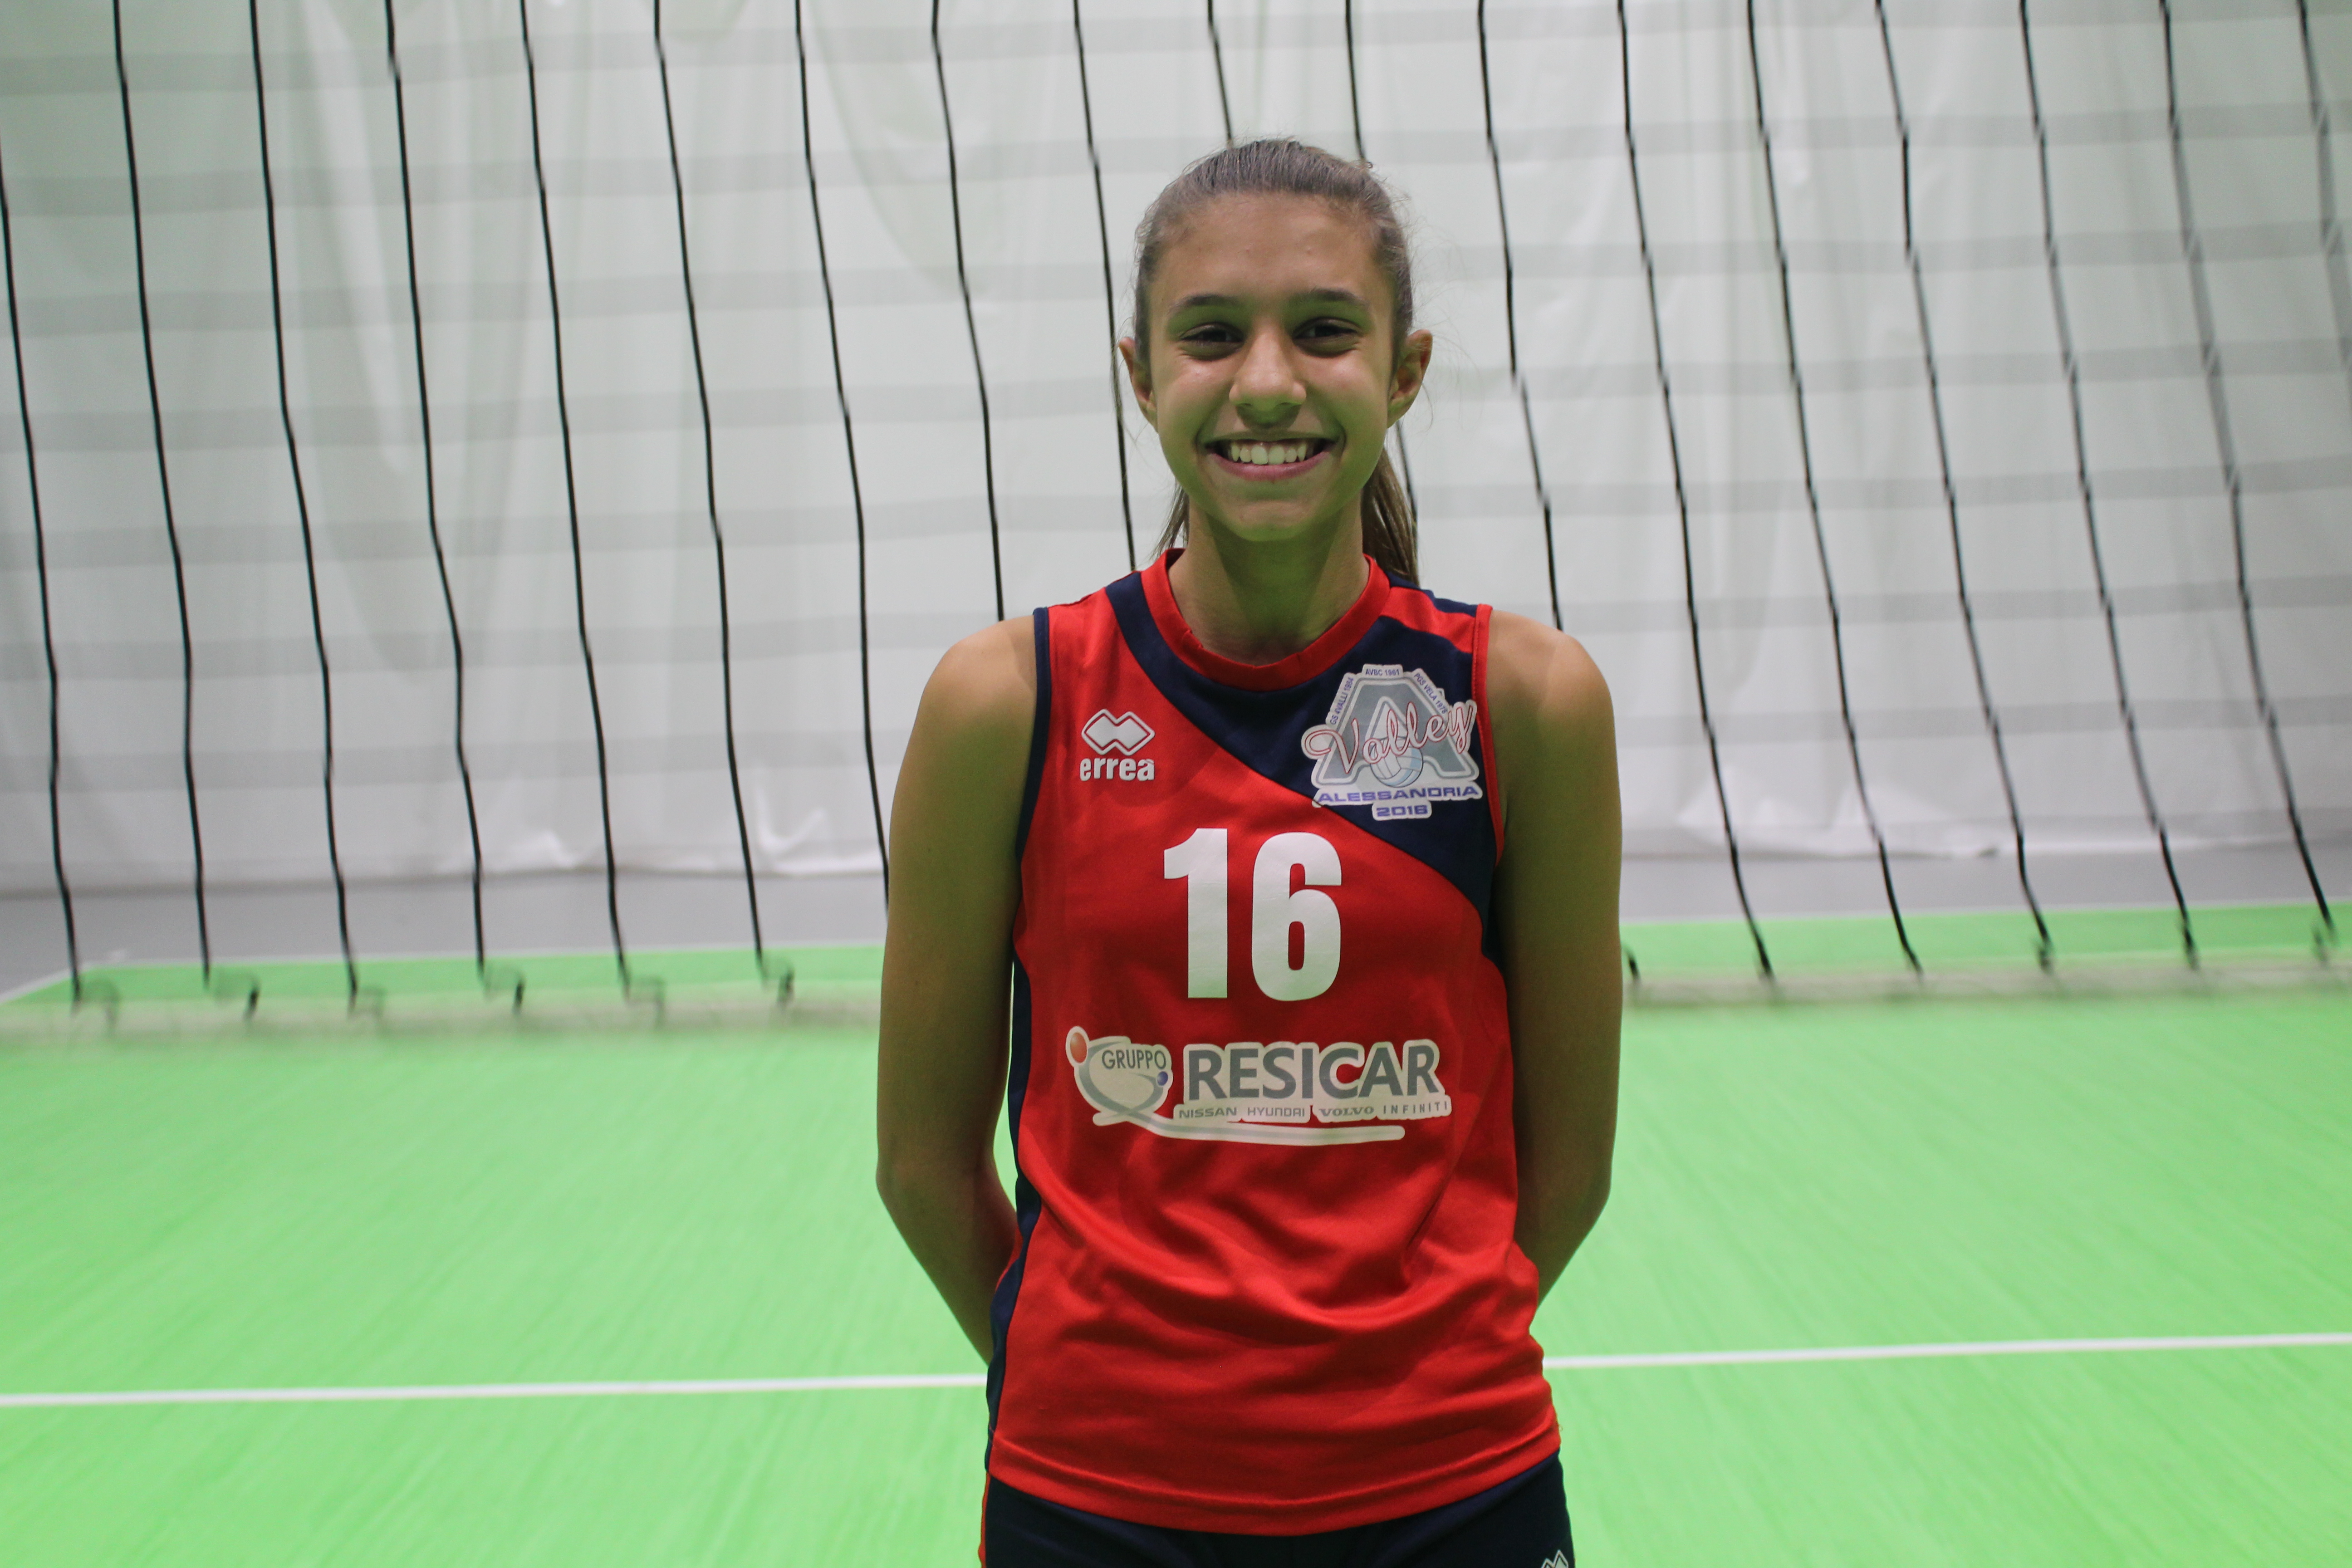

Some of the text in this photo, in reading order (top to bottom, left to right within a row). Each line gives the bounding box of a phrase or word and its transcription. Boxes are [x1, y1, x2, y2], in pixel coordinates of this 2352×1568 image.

[1414, 673, 1426, 686] PGS
[1424, 684, 1437, 701] VELA
[1330, 715, 1338, 725] GS
[1304, 701, 1474, 774] Volley
[1317, 786, 1479, 802] ALESSANDRIA
[1376, 805, 1428, 817] 2018
[1164, 828, 1342, 1001] 16
[1102, 1049, 1167, 1071] GRUPPO
[1188, 1044, 1440, 1101] RESICAR
[1179, 1101, 1447, 1118] NISSAN HYUNDAI VOLVO INFINITI
